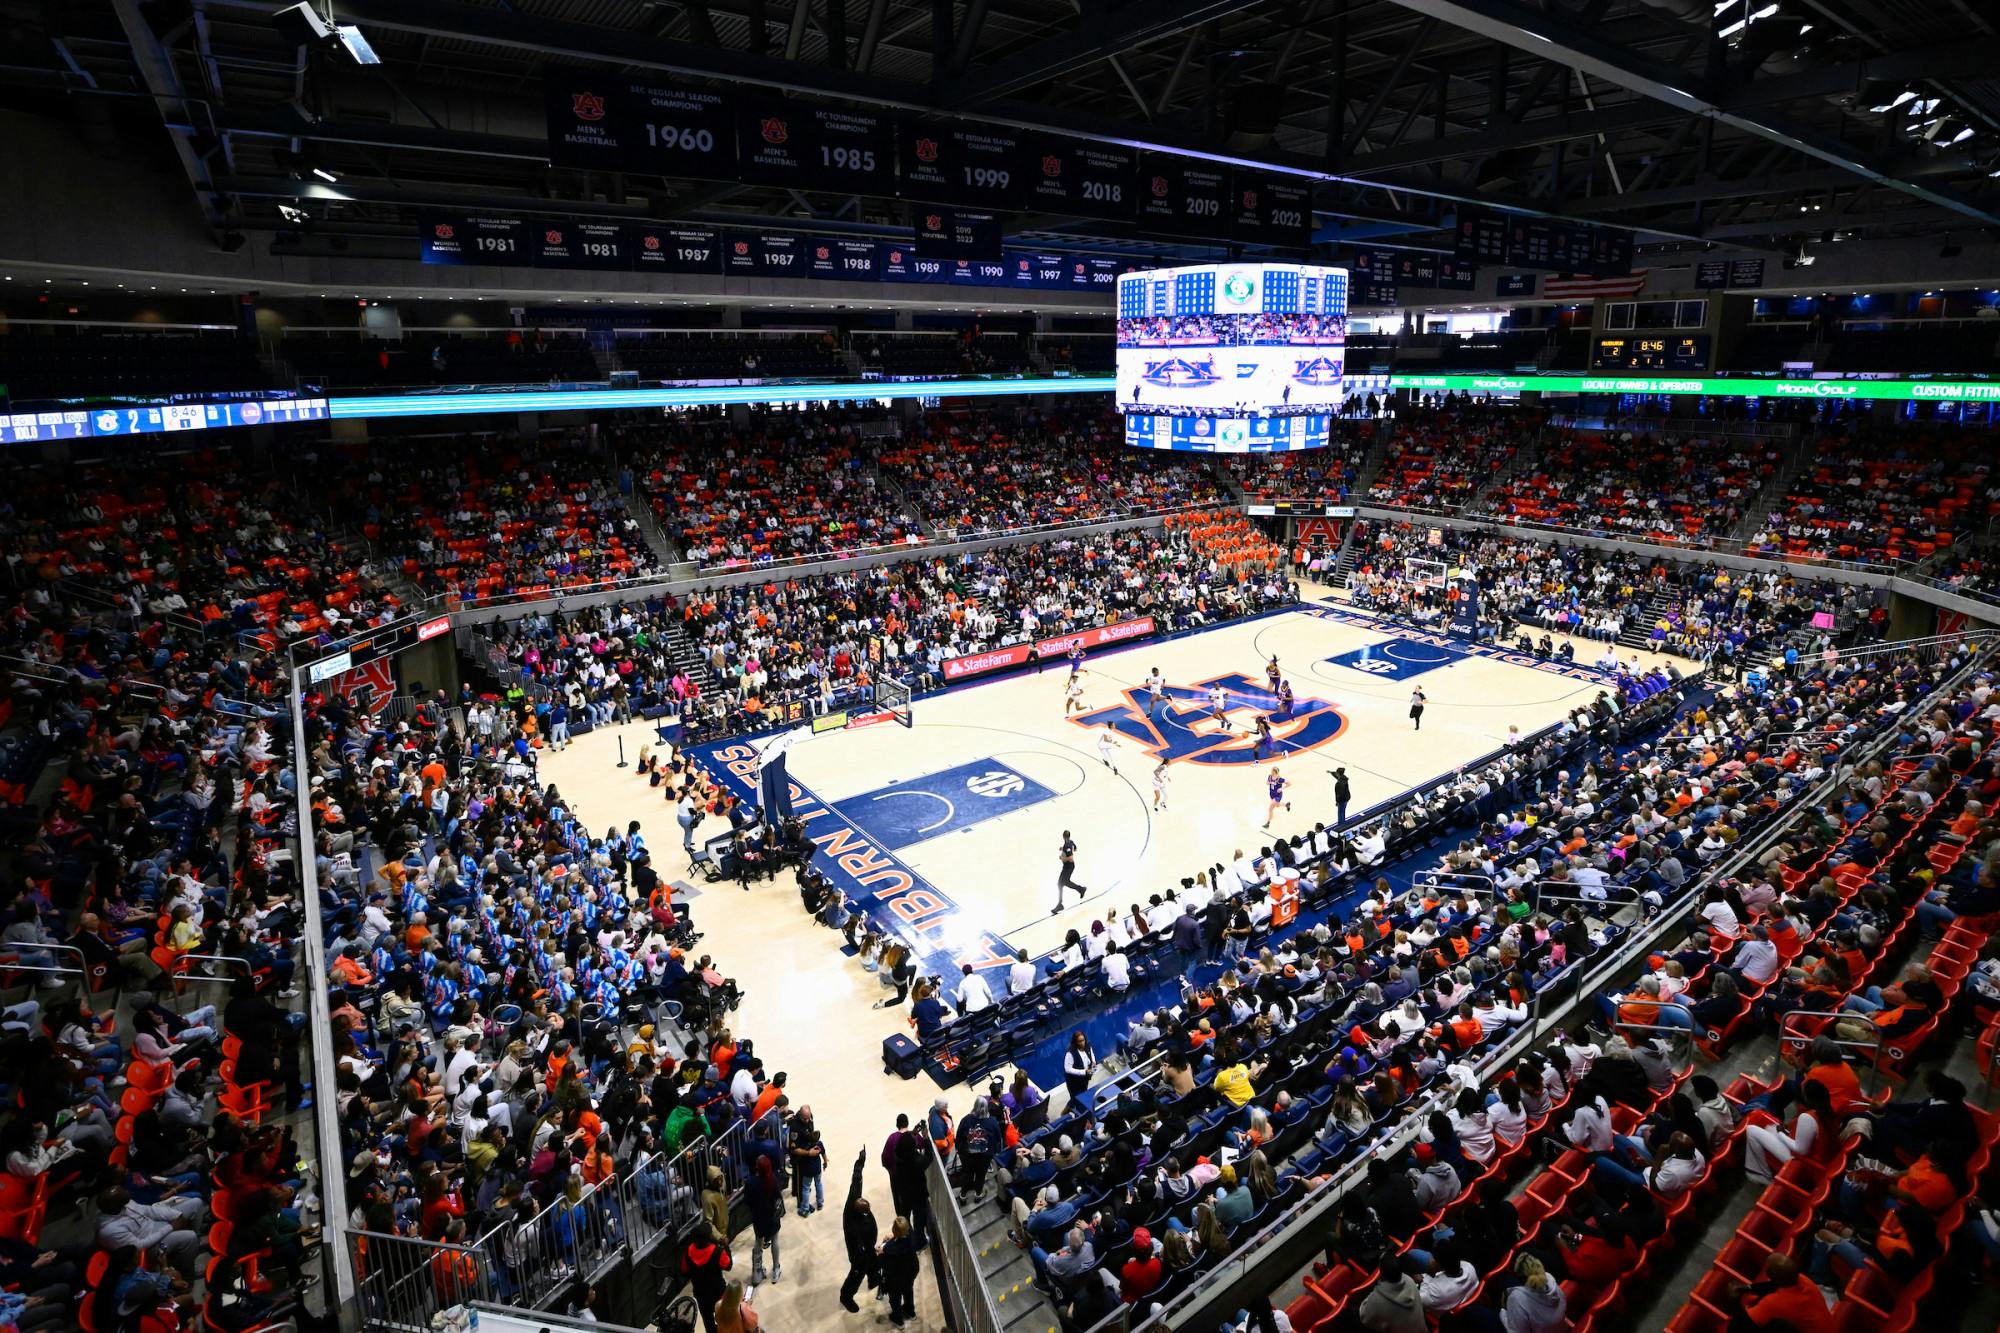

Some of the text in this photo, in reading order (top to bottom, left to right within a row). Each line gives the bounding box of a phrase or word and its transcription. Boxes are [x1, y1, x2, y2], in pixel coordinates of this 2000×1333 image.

[651, 97, 703, 112] CHAMPIONS
[576, 124, 606, 136] MEN'S
[825, 122, 868, 134] CHAMPIONS
[564, 134, 618, 147] BASKETBALL
[645, 123, 713, 152] 1960
[821, 145, 876, 172] 1985
[963, 166, 1010, 189] 1999
[1082, 181, 1122, 203] 2018
[1185, 197, 1219, 217] 2019
[1271, 209, 1301, 228] 2022
[476, 237, 515, 252] 1981
[583, 243, 618, 257] 1981
[677, 248, 710, 261] 1987
[764, 253, 795, 266] 1987
[843, 258, 871, 270] 1988
[914, 262, 940, 273] 1989
[979, 266, 1003, 277] 1990
[1039, 270, 1061, 280] 1997
[1093, 273, 1114, 283] 2009
[1613, 347, 1619, 355] 2
[1641, 341, 1663, 351] 8:46
[1690, 347, 1694, 355] 1
[1582, 380, 1615, 389] LOCALLY
[1617, 381, 1649, 390] OWNED
[1659, 382, 1702, 391] OPERATED
[1913, 385, 1962, 397] CUSTOM
[171, 407, 197, 418] 8:46
[224, 404, 232, 426] 1
[128, 409, 140, 433] 2
[50, 424, 57, 438] 1
[74, 422, 82, 436] 2
[558, 600, 565, 609] K
[1298, 609, 1456, 647] AUBURN
[789, 709, 800, 719] 26
